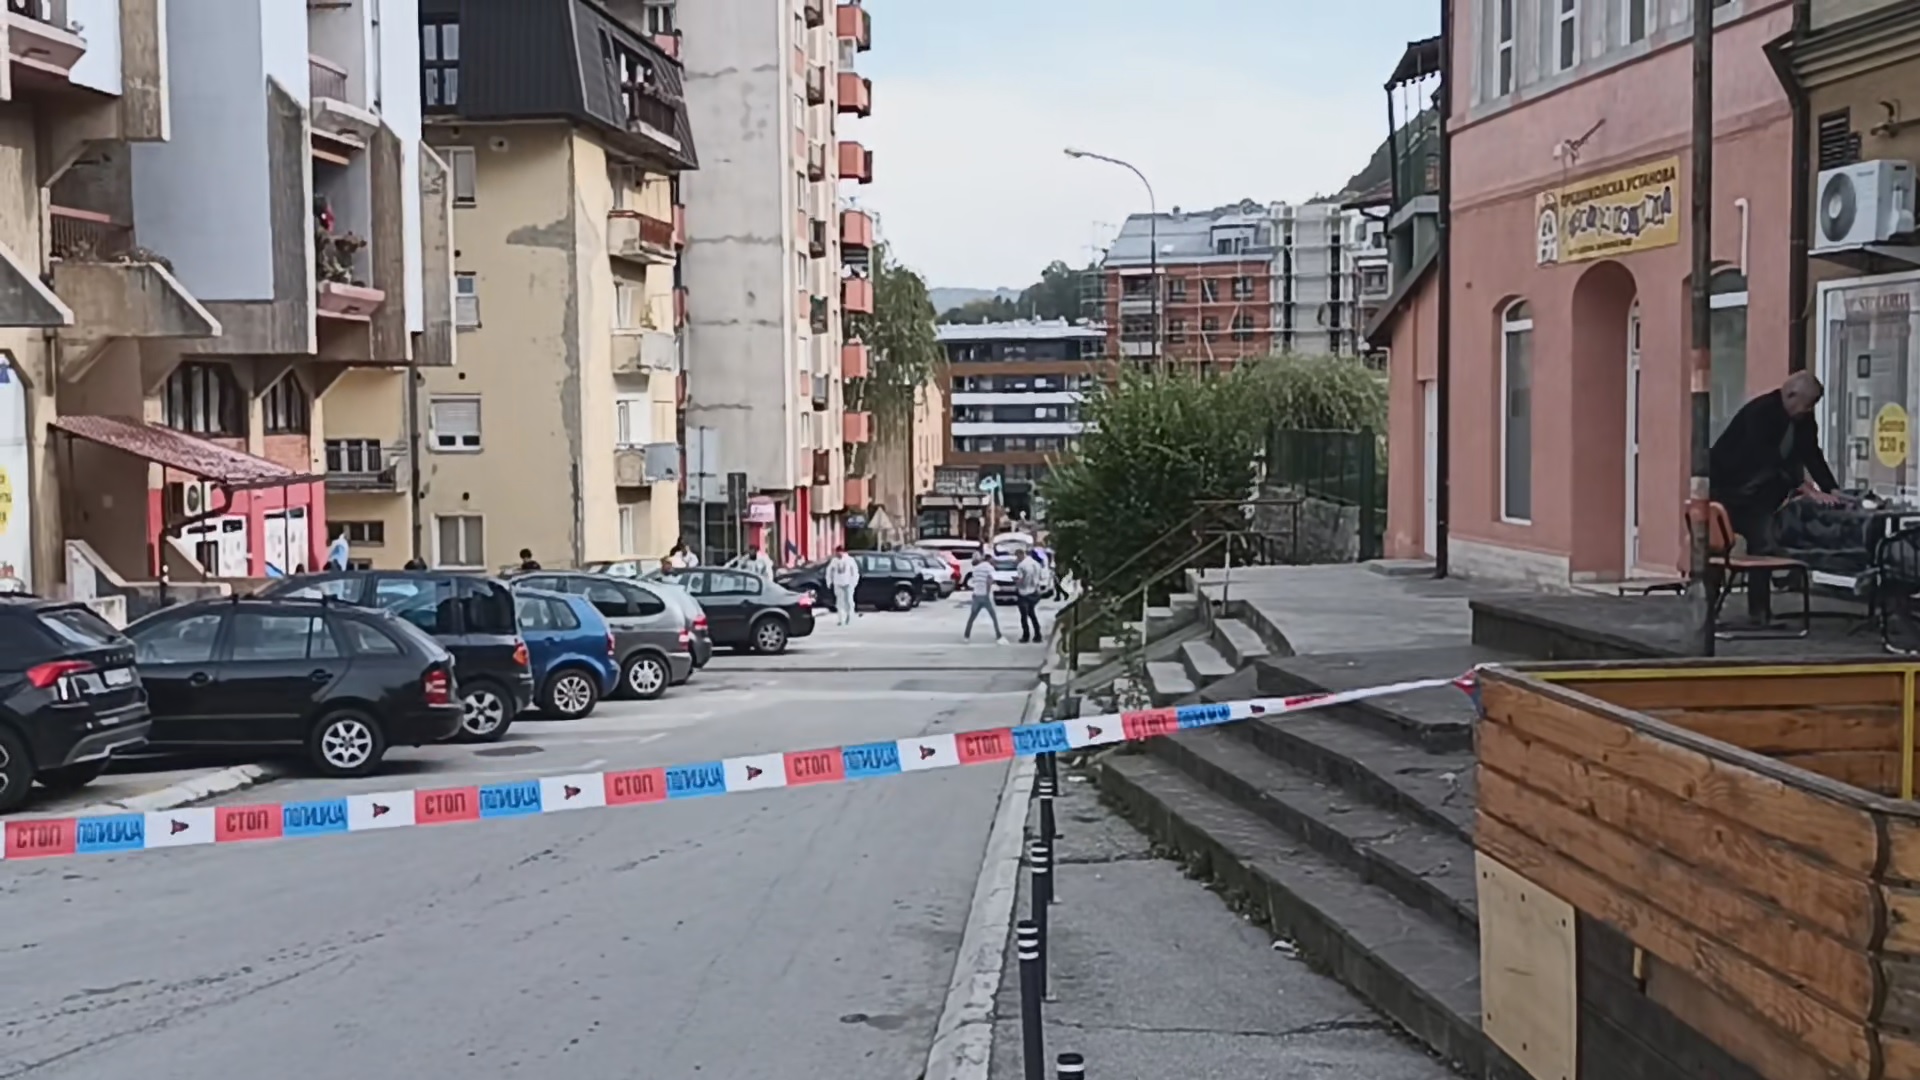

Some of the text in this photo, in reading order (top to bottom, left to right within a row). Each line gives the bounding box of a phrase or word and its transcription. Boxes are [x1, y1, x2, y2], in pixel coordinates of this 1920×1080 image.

[1625, 166, 1676, 192] УСТАНОВА
[16, 825, 62, 849] СТОП
[225, 809, 270, 833] СТОП
[424, 792, 466, 816] СТОП
[613, 773, 654, 797] СТОП
[793, 753, 833, 777] СТОП
[965, 733, 1002, 757] СТОП
